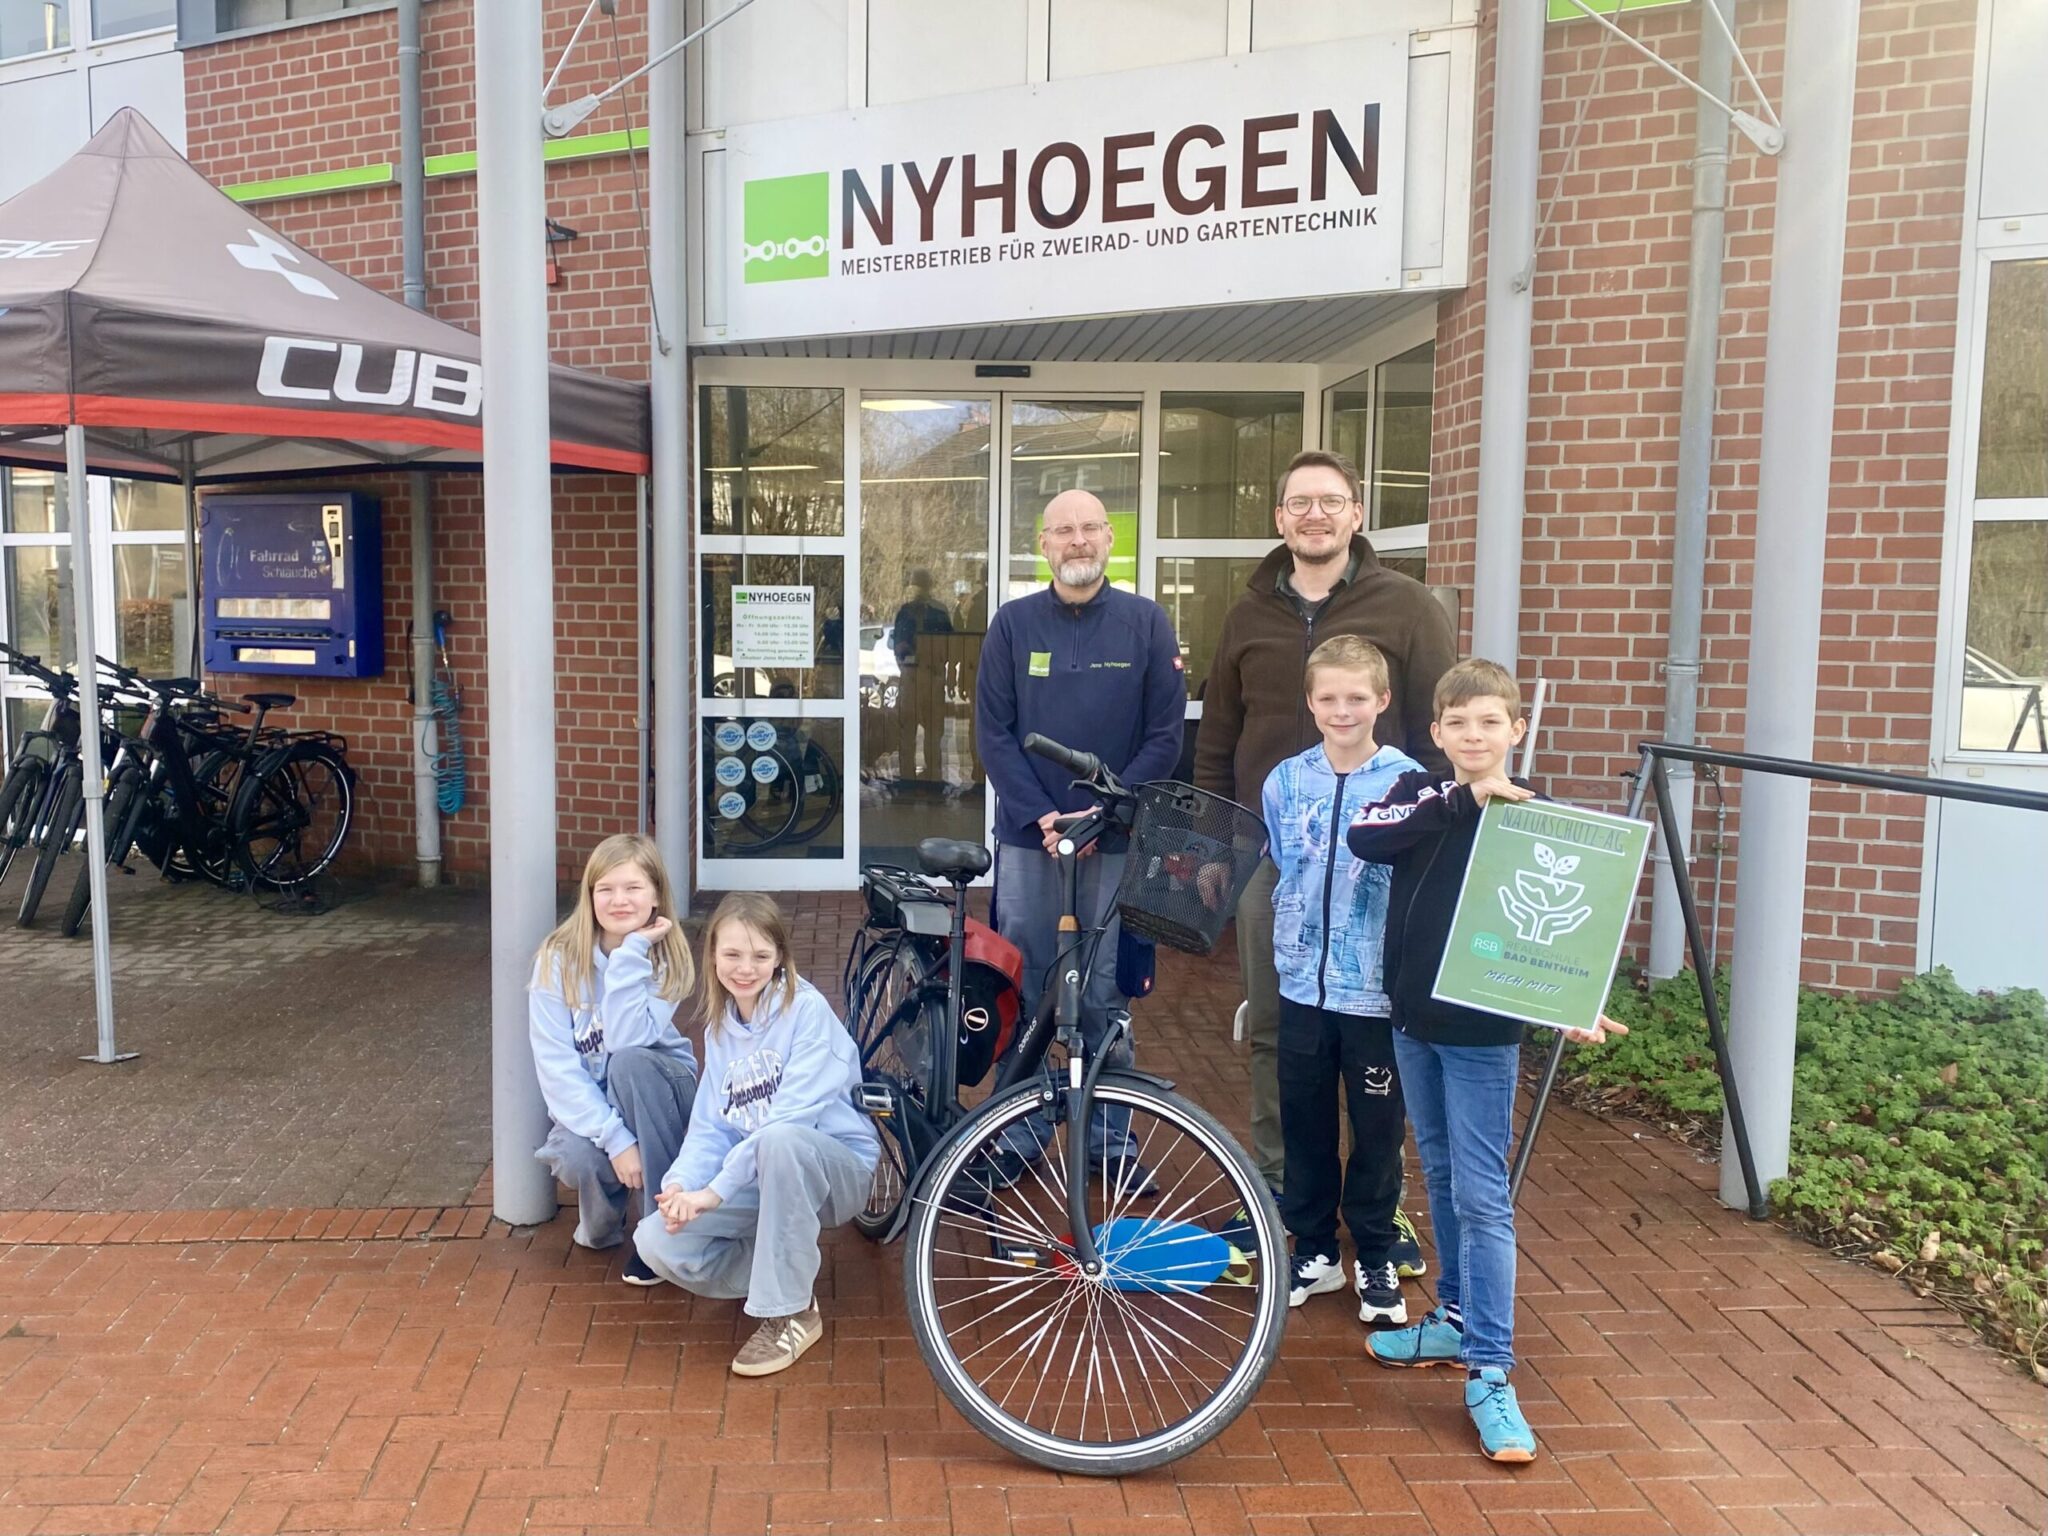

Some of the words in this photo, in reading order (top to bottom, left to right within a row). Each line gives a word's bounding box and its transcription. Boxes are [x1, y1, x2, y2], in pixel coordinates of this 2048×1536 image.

[842, 103, 1380, 250] NYHOEGEN
[841, 247, 992, 275] MEISTERBETRIEB
[999, 239, 1035, 261] FÜR
[1042, 232, 1139, 258] ZWEIRAD-
[1146, 226, 1189, 247] UND
[1197, 207, 1377, 242] GARTENTECHNIK
[256, 336, 482, 417] CUB
[249, 549, 299, 562] Fahrrad
[748, 592, 811, 602] NYHOEGEN
[1502, 806, 1624, 853] NATURSCHUTZ-AG
[1473, 937, 1498, 952] RSB
[1506, 942, 1581, 965] REALSCHULE
[1484, 969, 1525, 988] MACH
[1503, 951, 1528, 964] BAD
[1529, 958, 1589, 979] BENTHEIM
[976, 1101, 1011, 1127] MARATHON
[1012, 1091, 1030, 1104] PLUS
